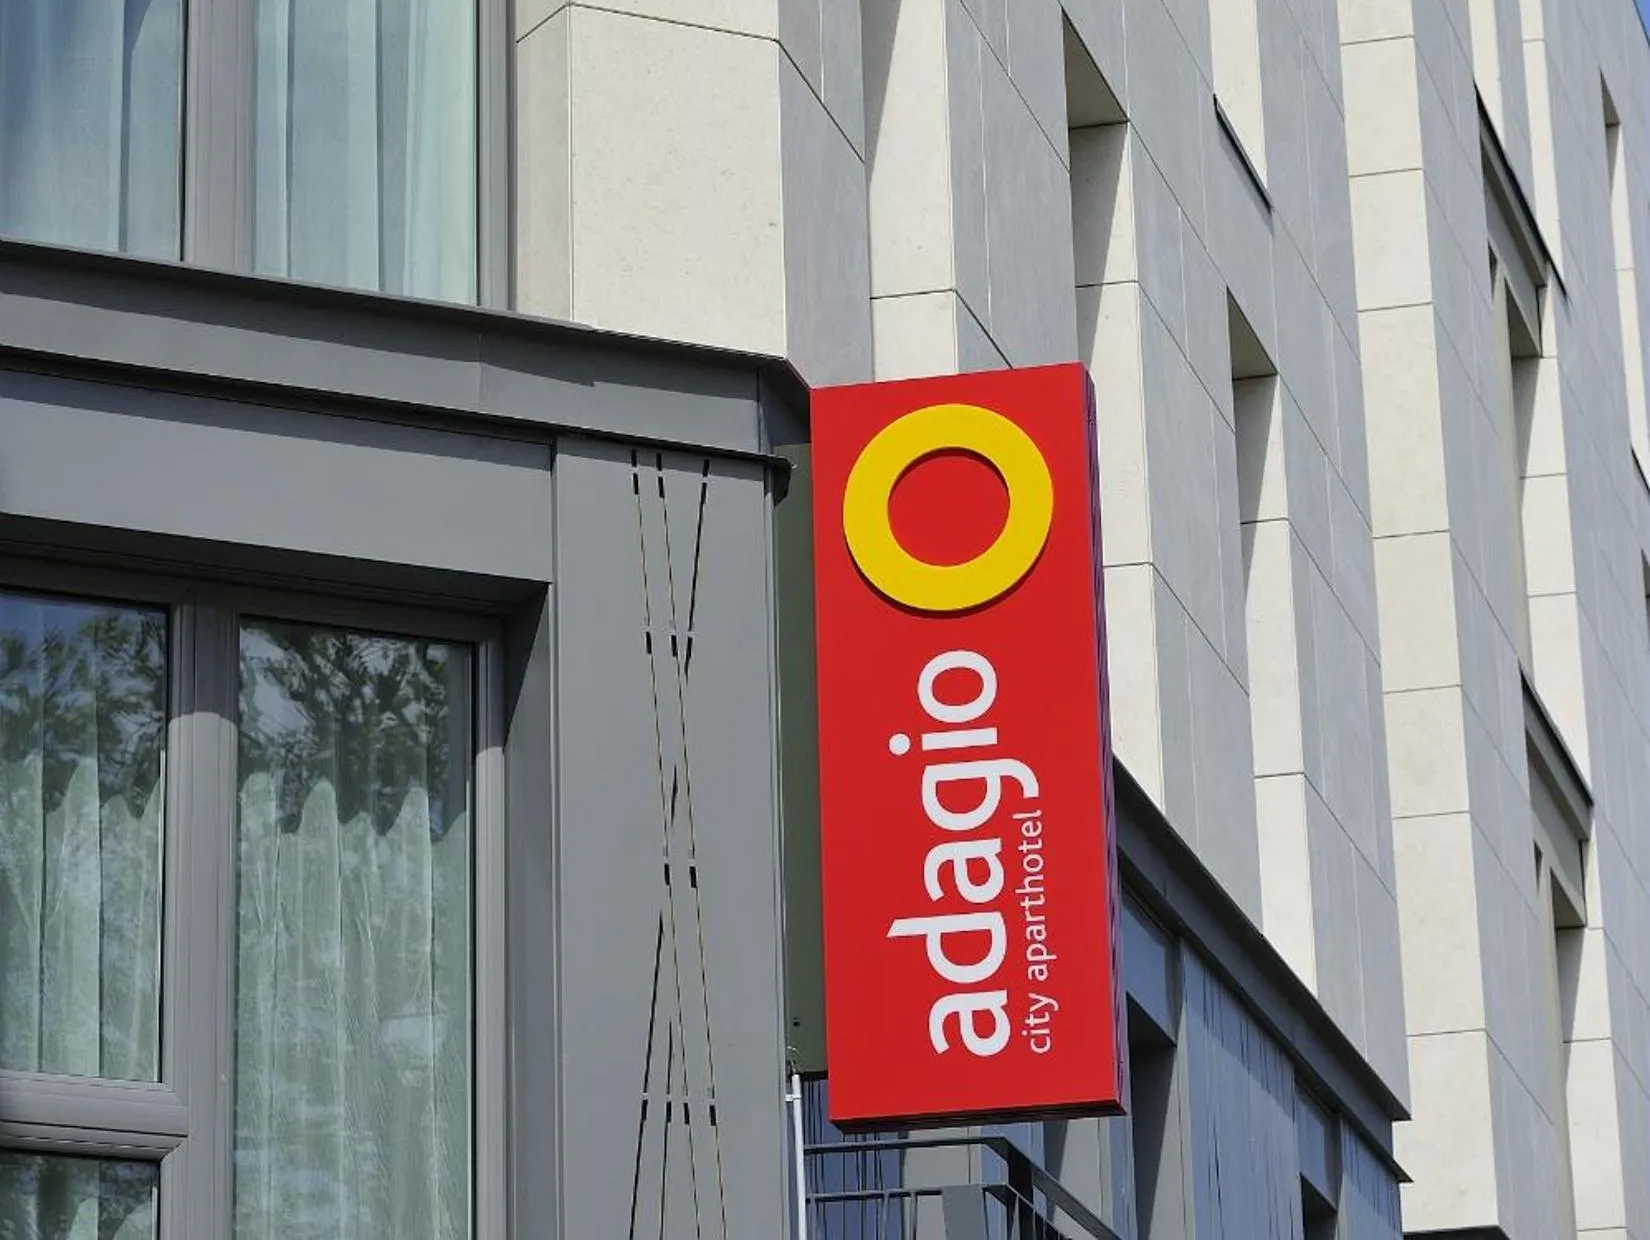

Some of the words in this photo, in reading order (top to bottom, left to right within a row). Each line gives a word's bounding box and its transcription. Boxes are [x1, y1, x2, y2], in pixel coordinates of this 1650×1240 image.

[887, 649, 1040, 1058] adagio
[1012, 808, 1058, 981] aparthotel
[1022, 992, 1060, 1055] city
